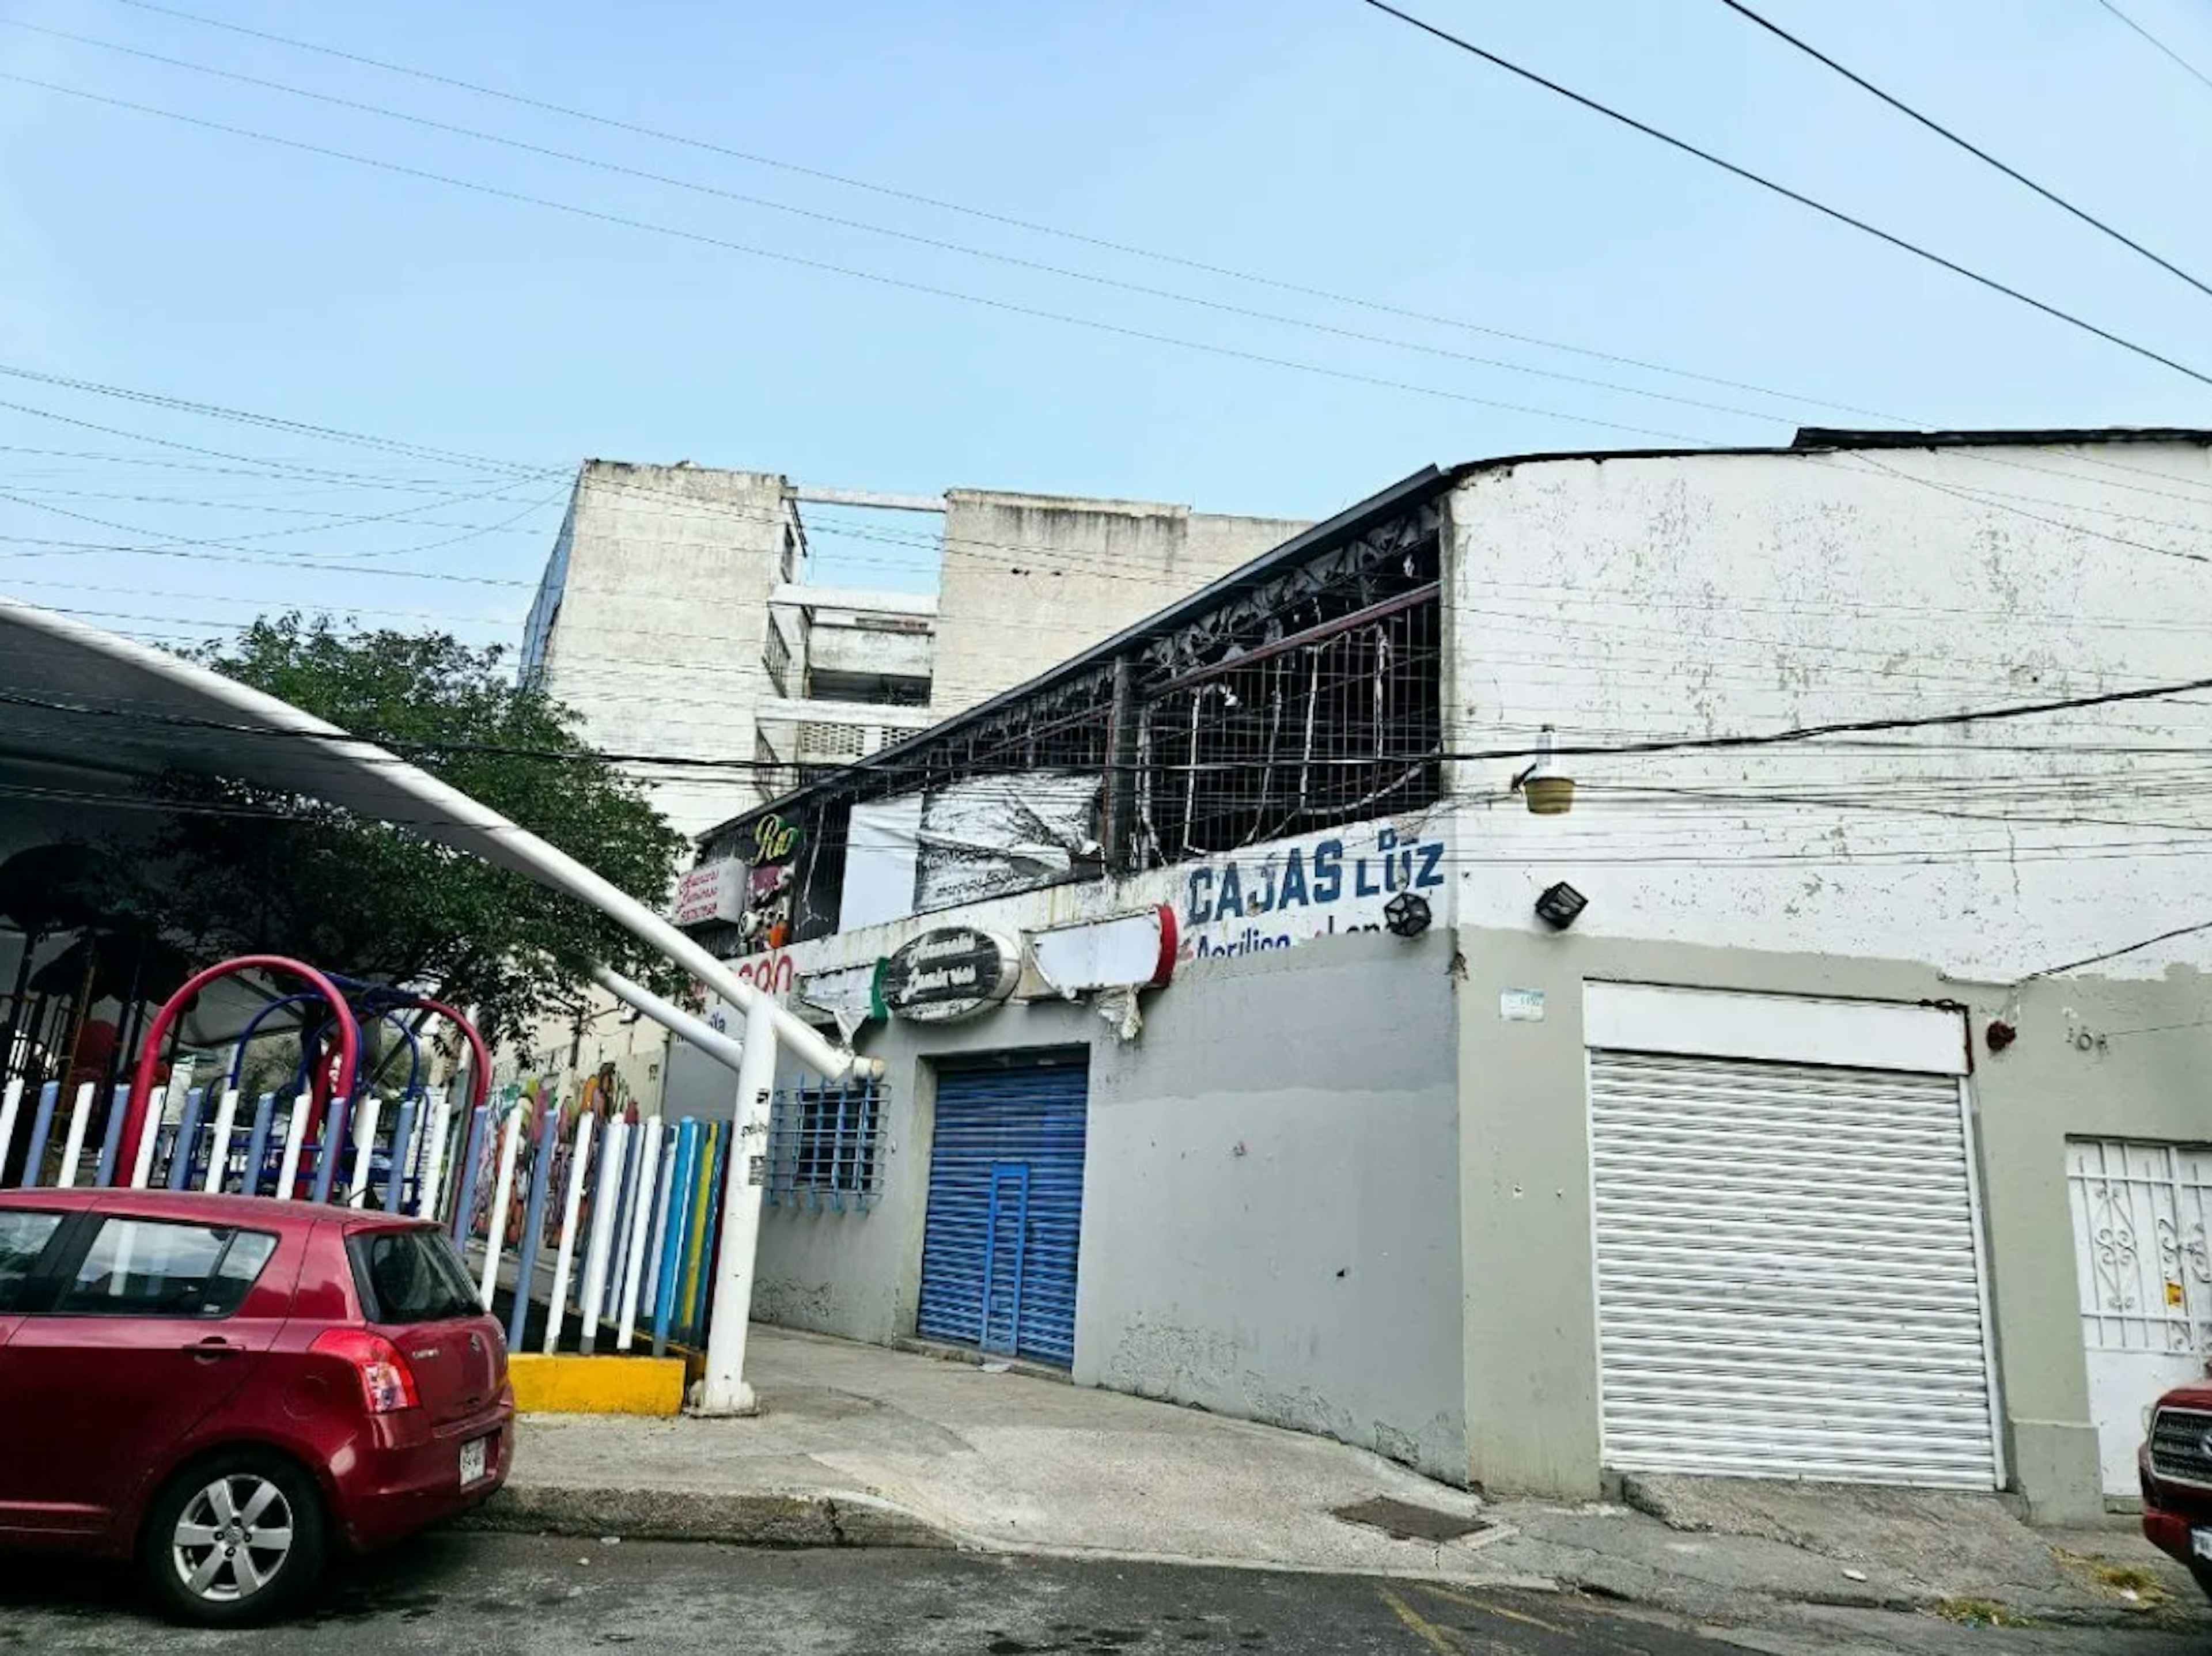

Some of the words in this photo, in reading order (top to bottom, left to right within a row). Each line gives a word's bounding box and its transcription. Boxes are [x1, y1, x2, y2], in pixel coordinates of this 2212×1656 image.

[1378, 828, 1419, 851] D
[1187, 839, 1343, 926] CAJAS
[1356, 842, 1444, 897] LUZ
